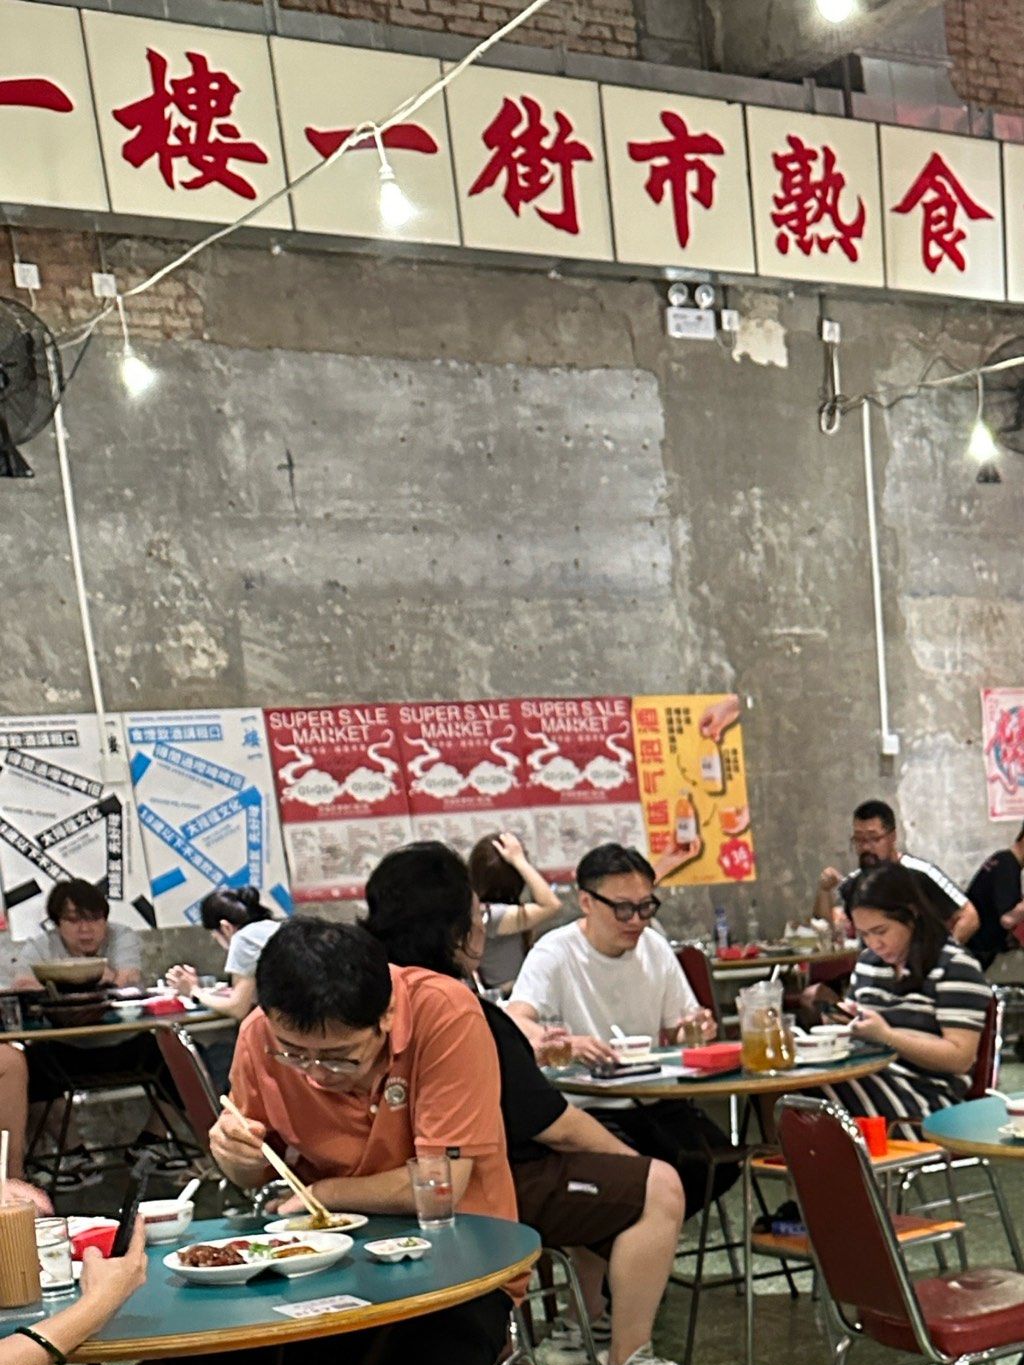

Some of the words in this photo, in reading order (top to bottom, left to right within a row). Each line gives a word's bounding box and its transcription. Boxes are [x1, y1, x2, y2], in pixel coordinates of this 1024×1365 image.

[269, 709, 335, 730] SUPER
[399, 704, 461, 724] SUPER
[520, 700, 579, 719] SUPER
